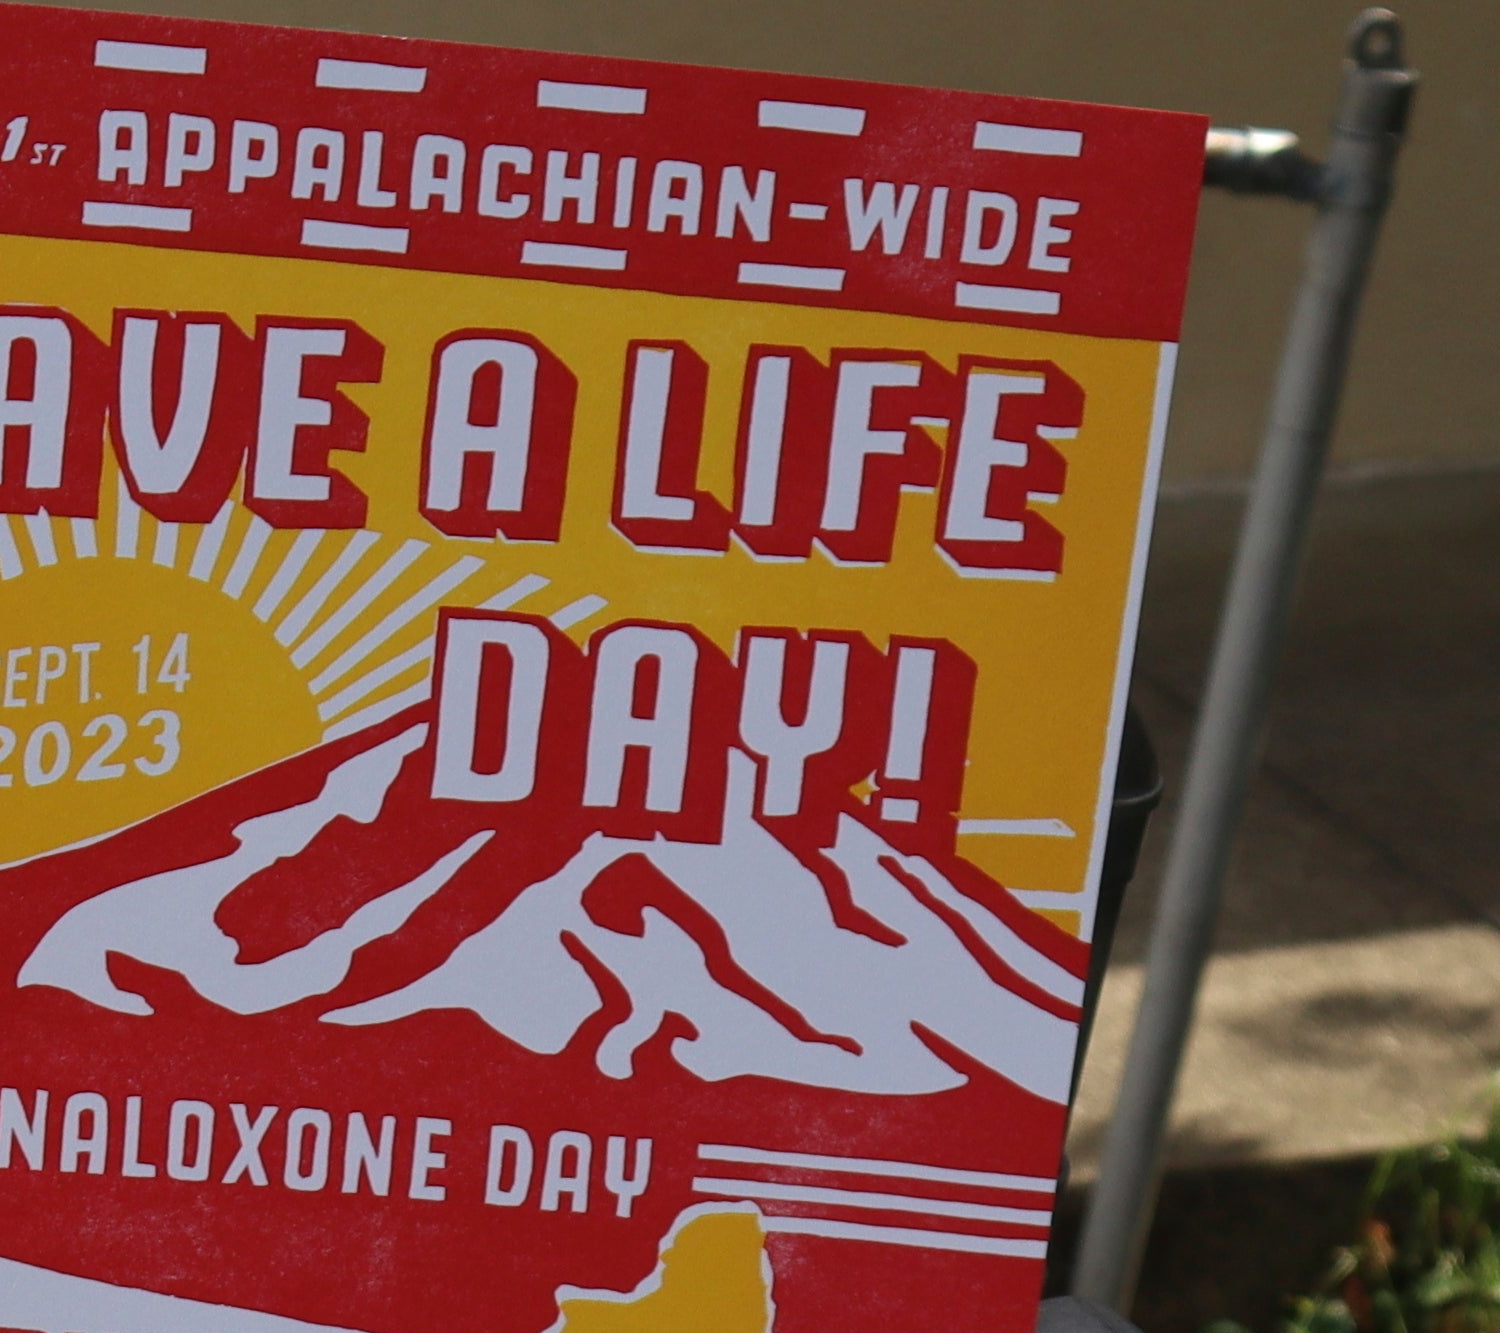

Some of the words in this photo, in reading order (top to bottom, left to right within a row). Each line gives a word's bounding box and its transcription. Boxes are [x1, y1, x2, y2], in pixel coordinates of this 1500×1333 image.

[0, 114, 66, 169] 1ST
[96, 108, 1081, 274] APPALACHIAN-WIDE
[420, 332, 565, 536] A
[615, 343, 1075, 568] LIFE
[130, 632, 191, 695] 14
[428, 612, 955, 835] DAY!
[484, 1128, 654, 1218] DAY
